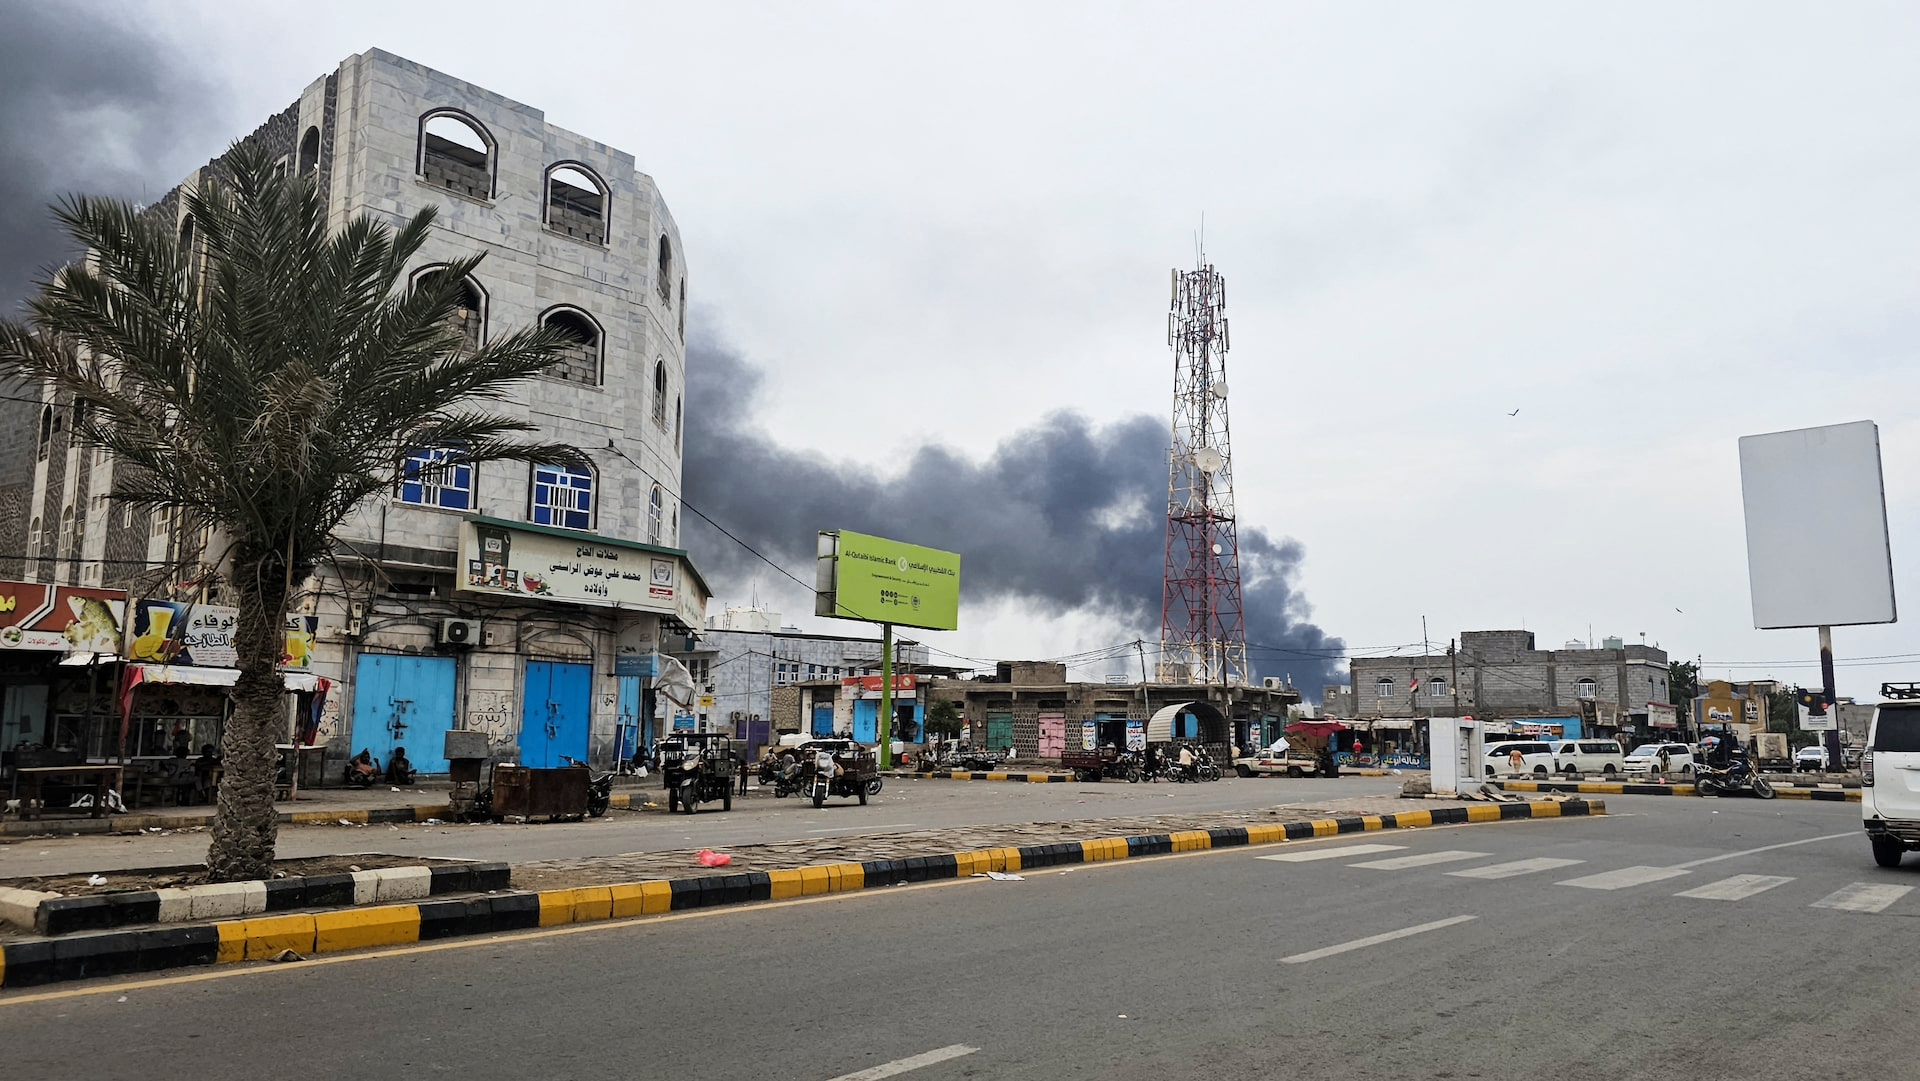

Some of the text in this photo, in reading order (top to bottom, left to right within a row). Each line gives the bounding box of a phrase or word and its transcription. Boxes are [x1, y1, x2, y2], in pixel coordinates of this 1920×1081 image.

[576, 545, 619, 561] محلات الحاج
[885, 557, 896, 565] Bank
[583, 564, 603, 578] عوض
[605, 567, 620, 583] علي
[622, 570, 641, 582] محمد
[584, 581, 608, 596] وأولاده
[184, 632, 230, 648] الطازجة
